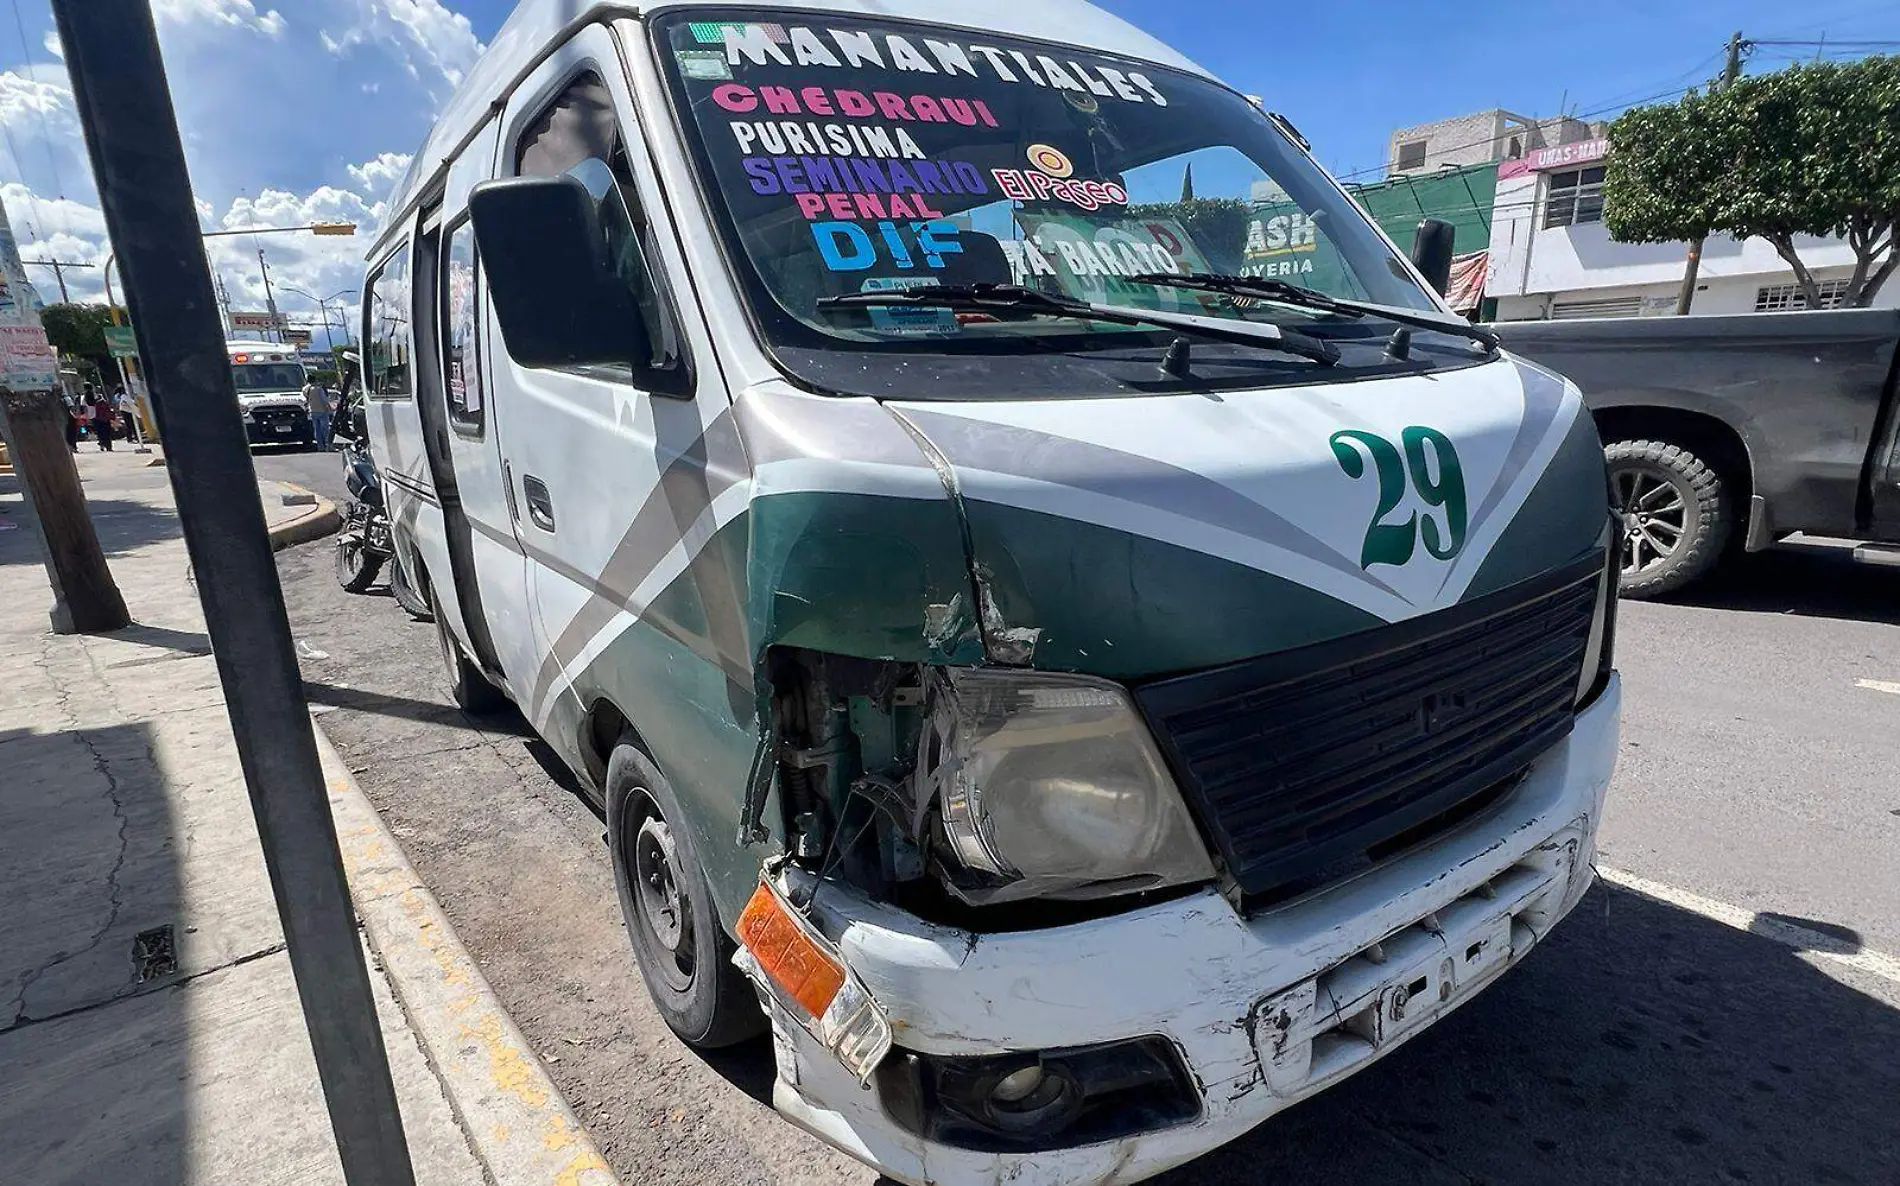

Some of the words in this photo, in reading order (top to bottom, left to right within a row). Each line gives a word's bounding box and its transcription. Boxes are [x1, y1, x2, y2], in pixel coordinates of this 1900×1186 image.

[721, 25, 1168, 107] MANANTIALES
[711, 84, 999, 128] CHEDRAUI
[728, 121, 926, 160] PURISIMA
[743, 157, 988, 195] SEMINARIO
[991, 169, 1035, 200] El
[1024, 170, 1129, 211] Paseo
[793, 191, 943, 220] PENAL
[809, 221, 963, 272] DIF
[1055, 240, 1180, 276] BARATO
[1329, 426, 1467, 571] 29
